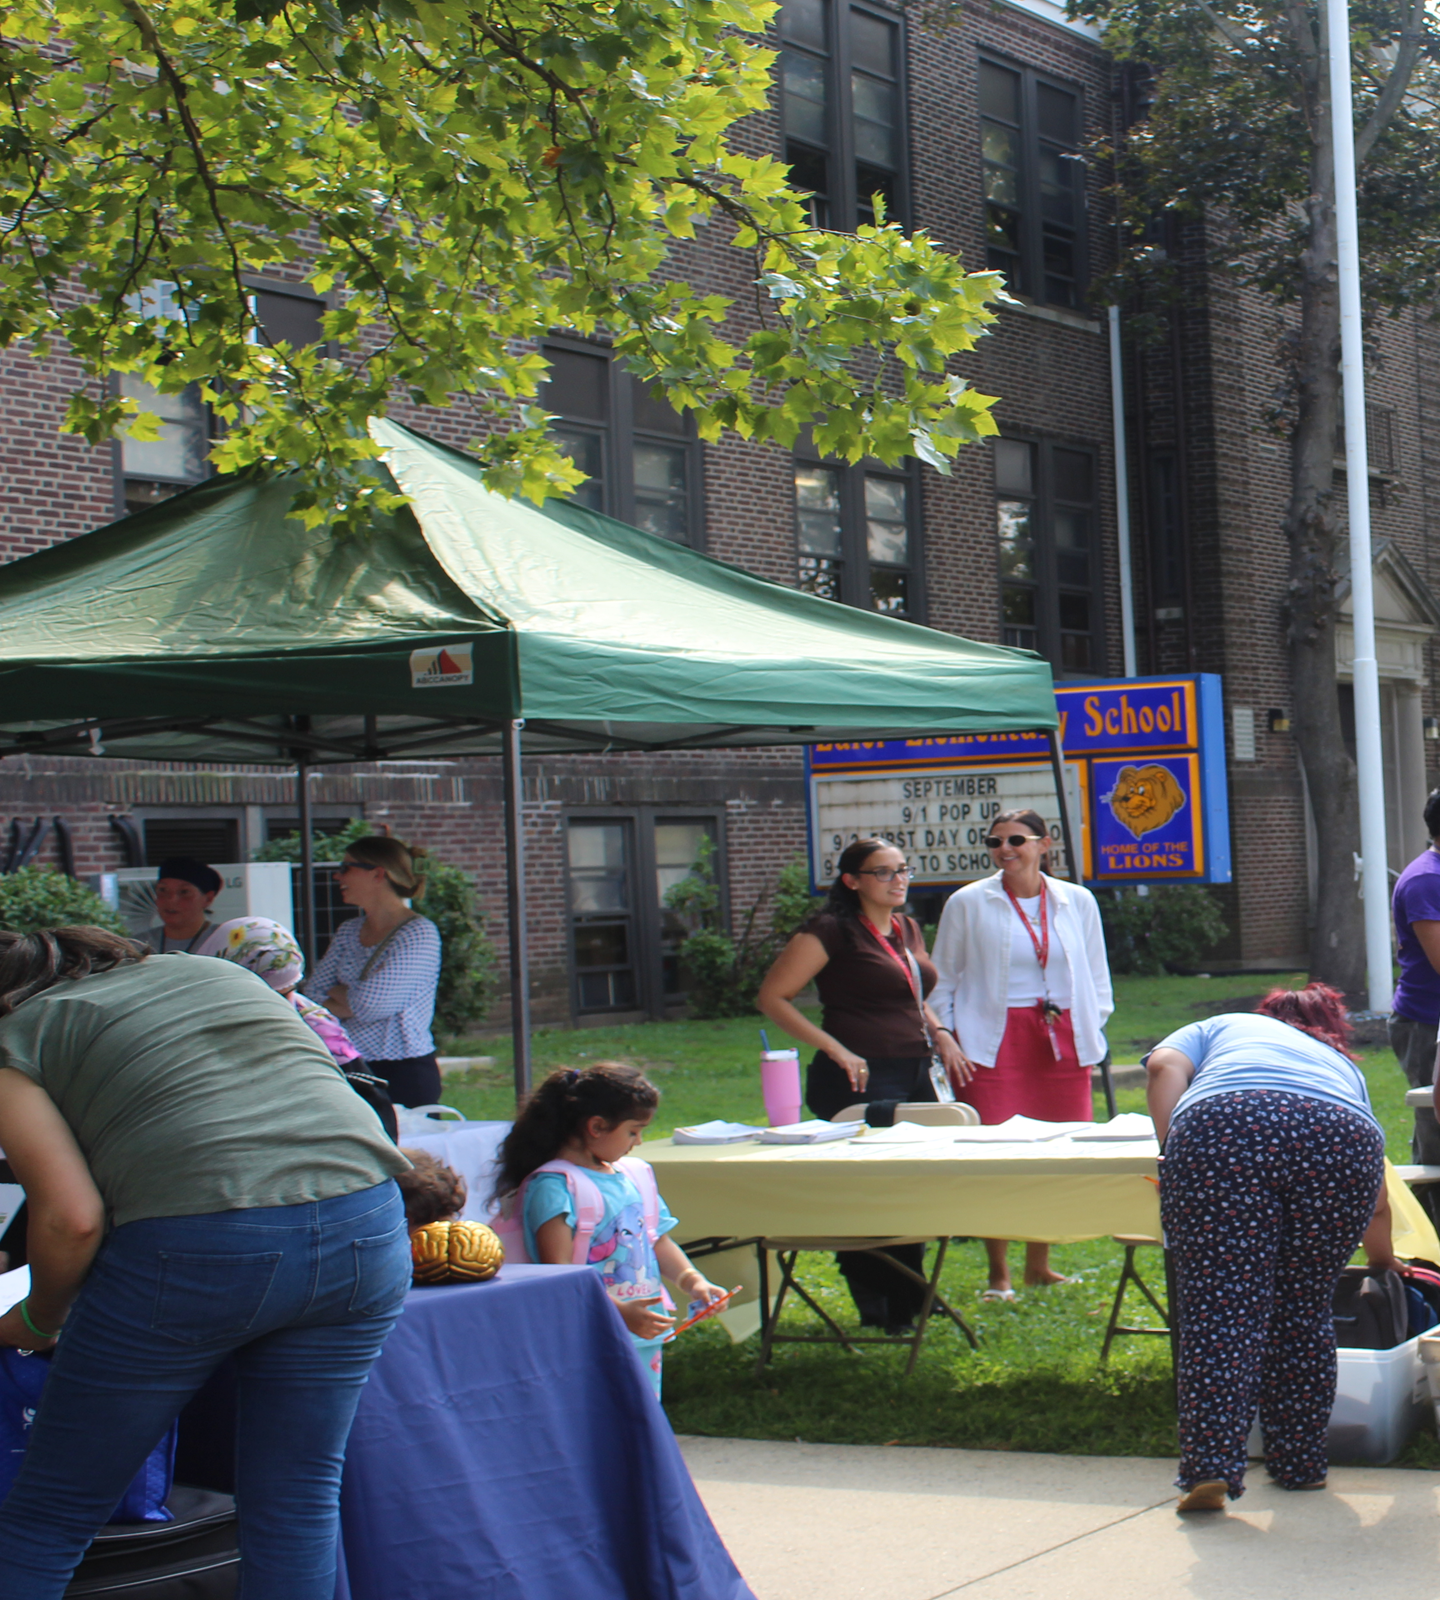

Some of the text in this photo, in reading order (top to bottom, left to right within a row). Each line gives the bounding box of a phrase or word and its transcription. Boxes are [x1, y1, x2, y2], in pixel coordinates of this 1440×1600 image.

[1084, 691, 1183, 737] School
[902, 777, 997, 798] SEPTEMBER
[902, 802, 1001, 823] 9/1 POP UP
[925, 828, 958, 847] DAY
[967, 827, 987, 845] OF
[1101, 841, 1189, 855] HOME OF THE
[919, 855, 940, 872] TO
[947, 853, 1001, 872] SCHO
[1108, 853, 1184, 870] LIONS
[225, 876, 243, 889] LG
